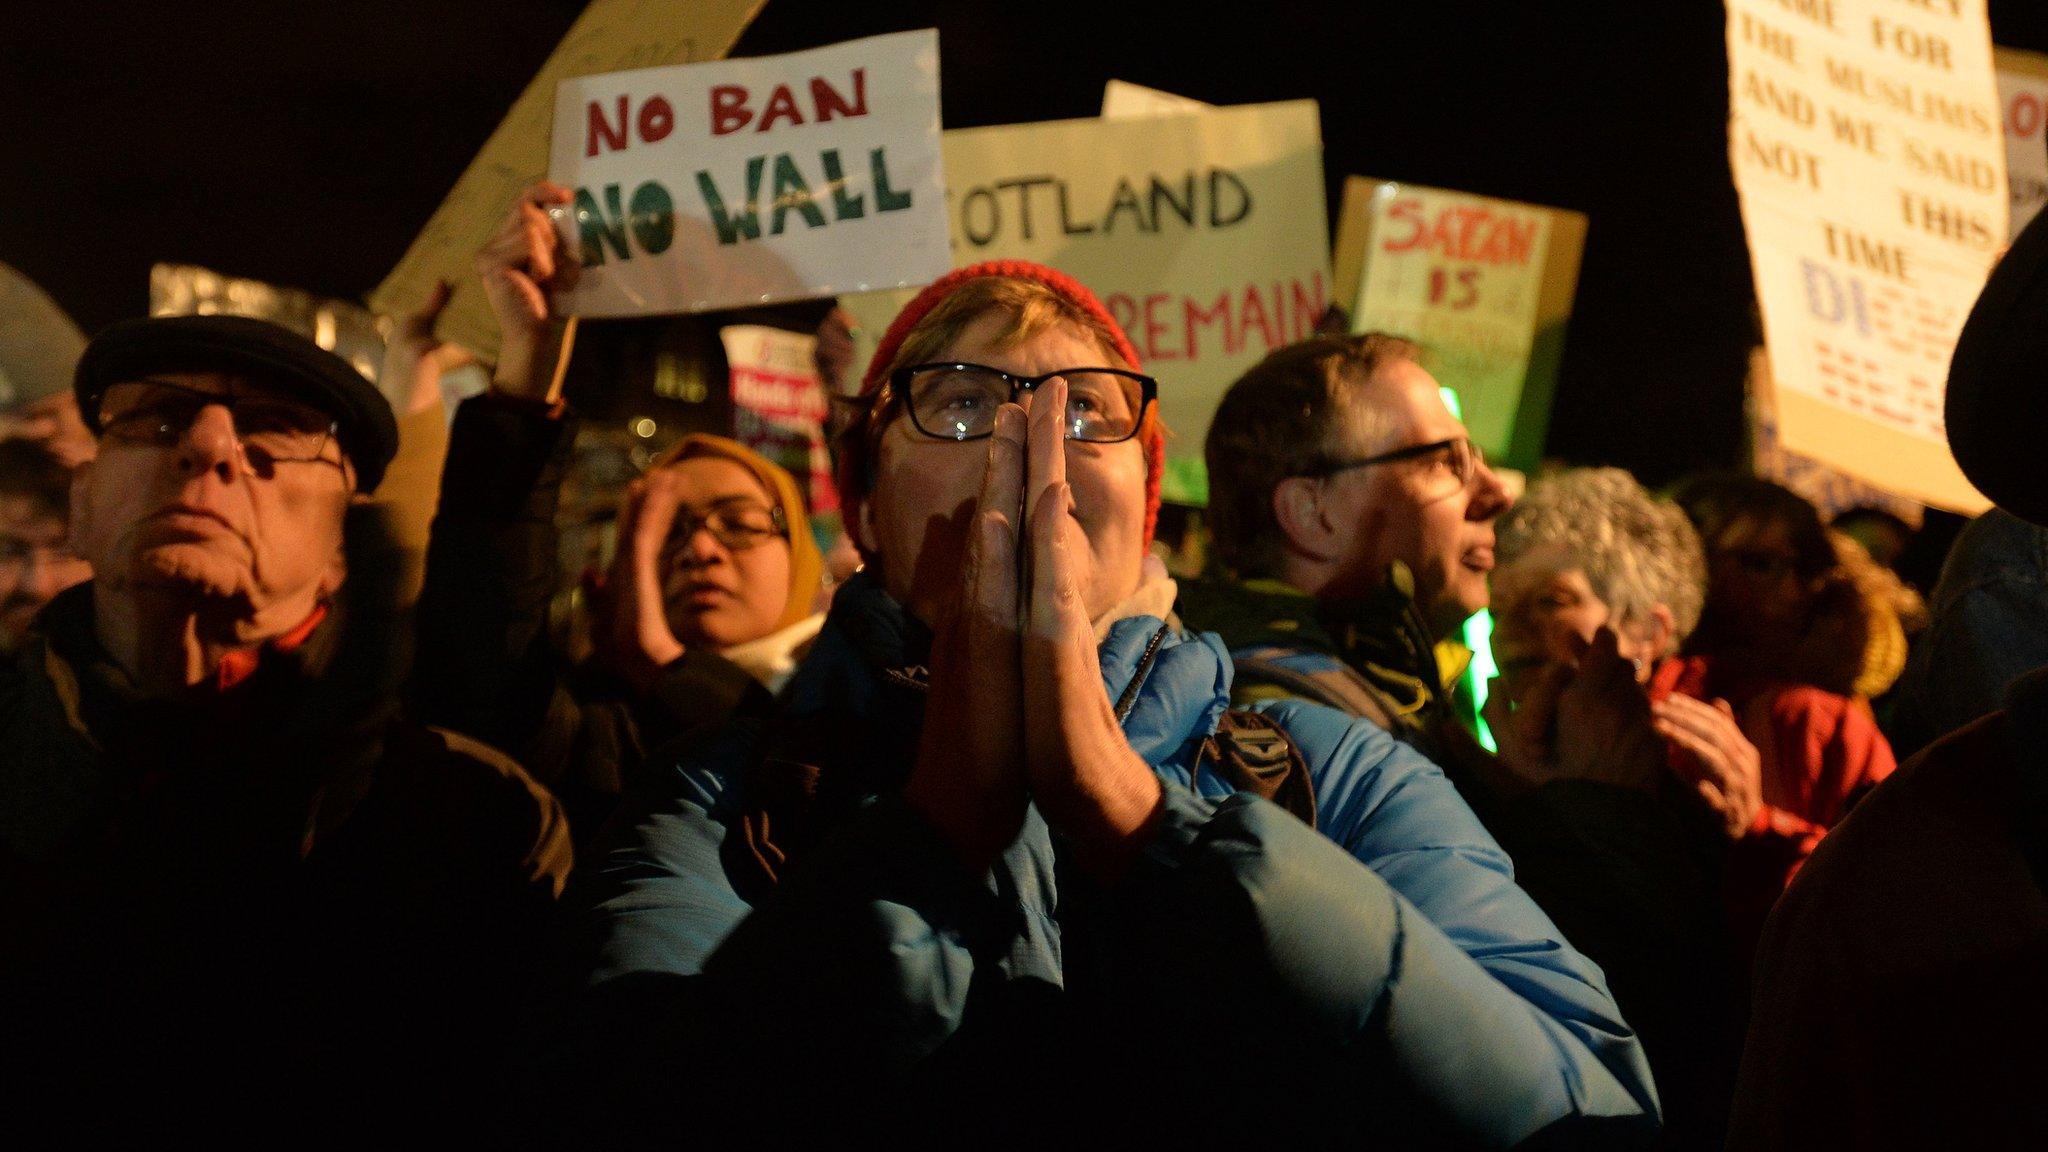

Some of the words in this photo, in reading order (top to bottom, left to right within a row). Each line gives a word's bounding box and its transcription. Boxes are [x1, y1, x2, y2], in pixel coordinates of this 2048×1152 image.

[1741, 11, 1804, 70] THE
[1823, 56, 1993, 136] MUSLIMS
[1869, 14, 1955, 72] FOR
[586, 94, 675, 157] NO
[709, 67, 869, 138] BAN
[1745, 68, 1818, 129] AND
[1827, 106, 1882, 156] WE
[1904, 138, 1996, 195] SAID
[574, 181, 676, 269] NO
[696, 145, 912, 247] WALL
[950, 166, 1253, 248] OTLAND
[1746, 130, 1821, 192] NOT
[1899, 188, 1993, 245] THIS
[1428, 265, 1481, 312] IS
[1823, 221, 1914, 284] TIME
[1107, 268, 1325, 361] REMAIN
